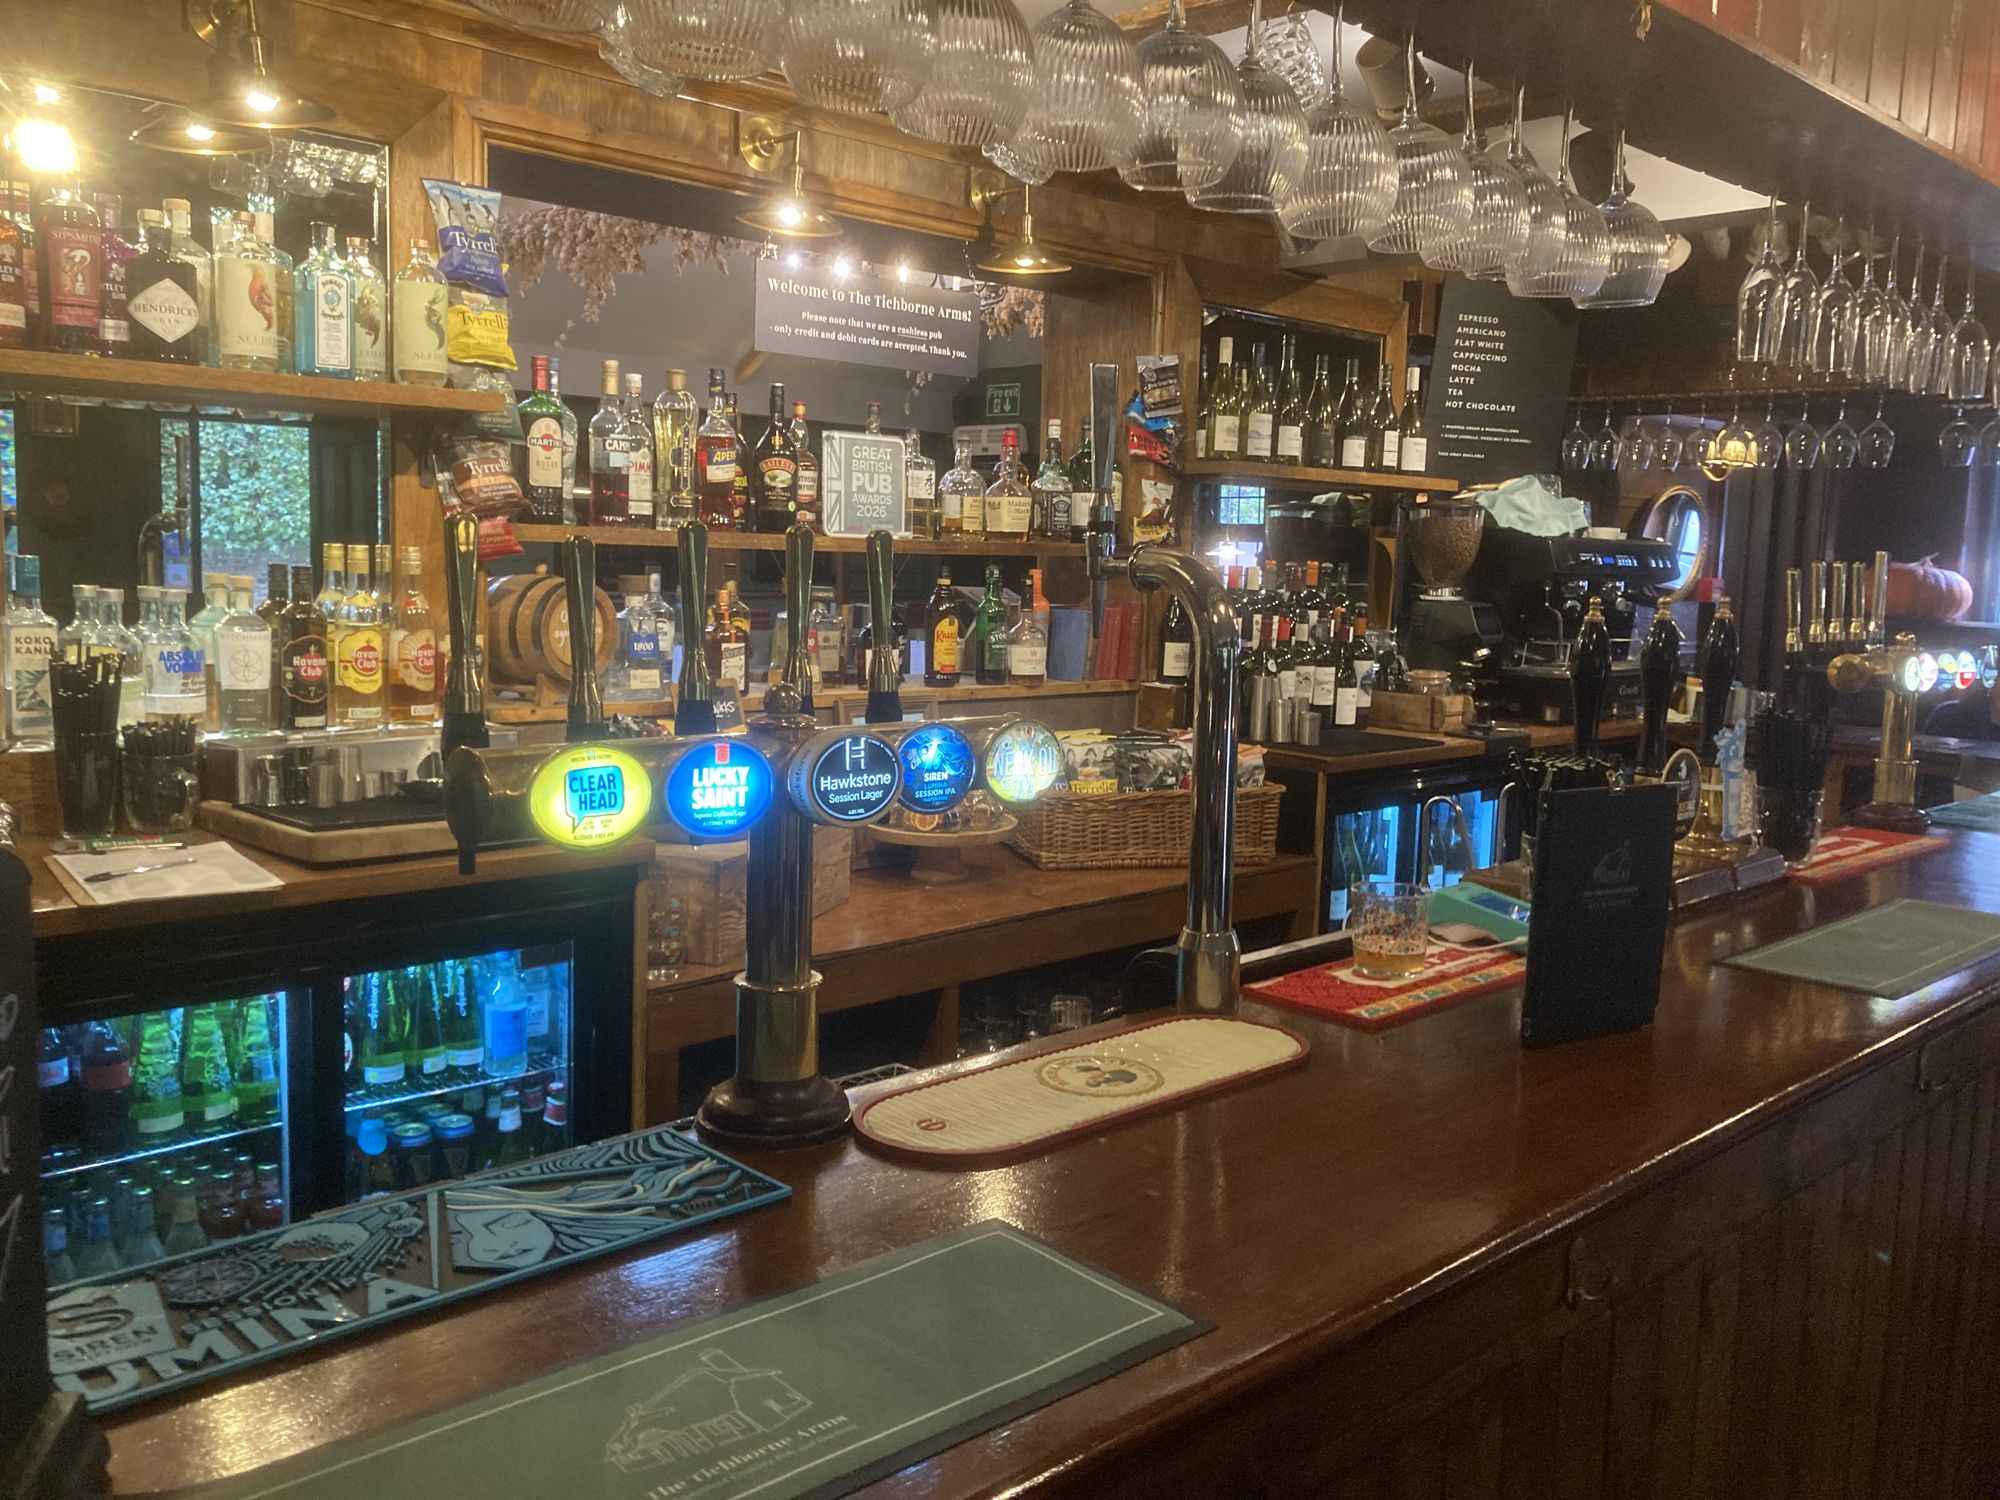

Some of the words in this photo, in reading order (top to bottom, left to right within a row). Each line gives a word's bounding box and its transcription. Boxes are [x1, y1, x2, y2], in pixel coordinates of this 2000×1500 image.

[450, 231, 497, 253] Tyrrell
[768, 277, 829, 300] Welcome
[832, 290, 845, 302] to
[848, 290, 871, 306] The
[874, 295, 935, 316] Tichborne
[938, 307, 972, 322] Arms!
[1458, 314, 1499, 324] ESPRESSO
[802, 311, 828, 323] Please
[828, 316, 847, 326] note
[848, 317, 864, 328] that
[866, 322, 876, 330] we
[878, 324, 891, 333] are
[898, 325, 928, 338] cashless
[928, 329, 943, 341] pub
[1456, 326, 1506, 337] AMERICANO
[774, 323, 792, 336] only
[794, 326, 819, 338] credit
[820, 329, 836, 340] and
[837, 332, 858, 344] debit
[858, 334, 880, 346] cards
[880, 338, 894, 348] are
[894, 340, 928, 354] accepted.
[929, 346, 951, 356] Thank
[951, 348, 968, 359] you.
[1455, 338, 1475, 346] FLAT
[1478, 341, 1504, 350] WHITE
[1453, 352, 1508, 362] CAPPUCCINO
[1451, 364, 1482, 372] MOCHA
[1449, 376, 1475, 384] LATTE
[989, 387, 1003, 398] Fire
[1004, 386, 1020, 398] exit
[1448, 388, 1464, 396] TEA
[1466, 402, 1516, 412] CHOCOLATE
[605, 439, 630, 451] CAMP
[852, 445, 893, 460] GREAT
[762, 459, 794, 470] BAILEYS
[852, 460, 893, 473] BRITISH
[851, 472, 892, 494] PUB
[851, 494, 892, 504] AWARDS
[856, 505, 887, 518] 2026
[15, 636, 52, 645] KOKO
[633, 641, 654, 652] 1800
[15, 646, 51, 655] KANU
[357, 658, 376, 669] Club
[301, 666, 322, 676] Club
[308, 686, 316, 696] 7
[1039, 747, 1058, 776] OIL
[568, 773, 617, 793] CLEAR
[692, 766, 750, 788] LUCKY
[820, 772, 892, 792] Hawkstone
[924, 772, 948, 782] SIREN
[924, 782, 948, 790] LUMINA
[691, 786, 749, 810] SAINT
[828, 792, 860, 804] Session
[860, 790, 884, 801] Lager
[915, 789, 944, 798] SESSION
[578, 792, 618, 811] HEAD
[52, 1324, 158, 1364] SIREN
[53, 1276, 440, 1402] UMINA
[692, 1436, 793, 1483] Tichborne
[798, 1415, 848, 1439] Arms
